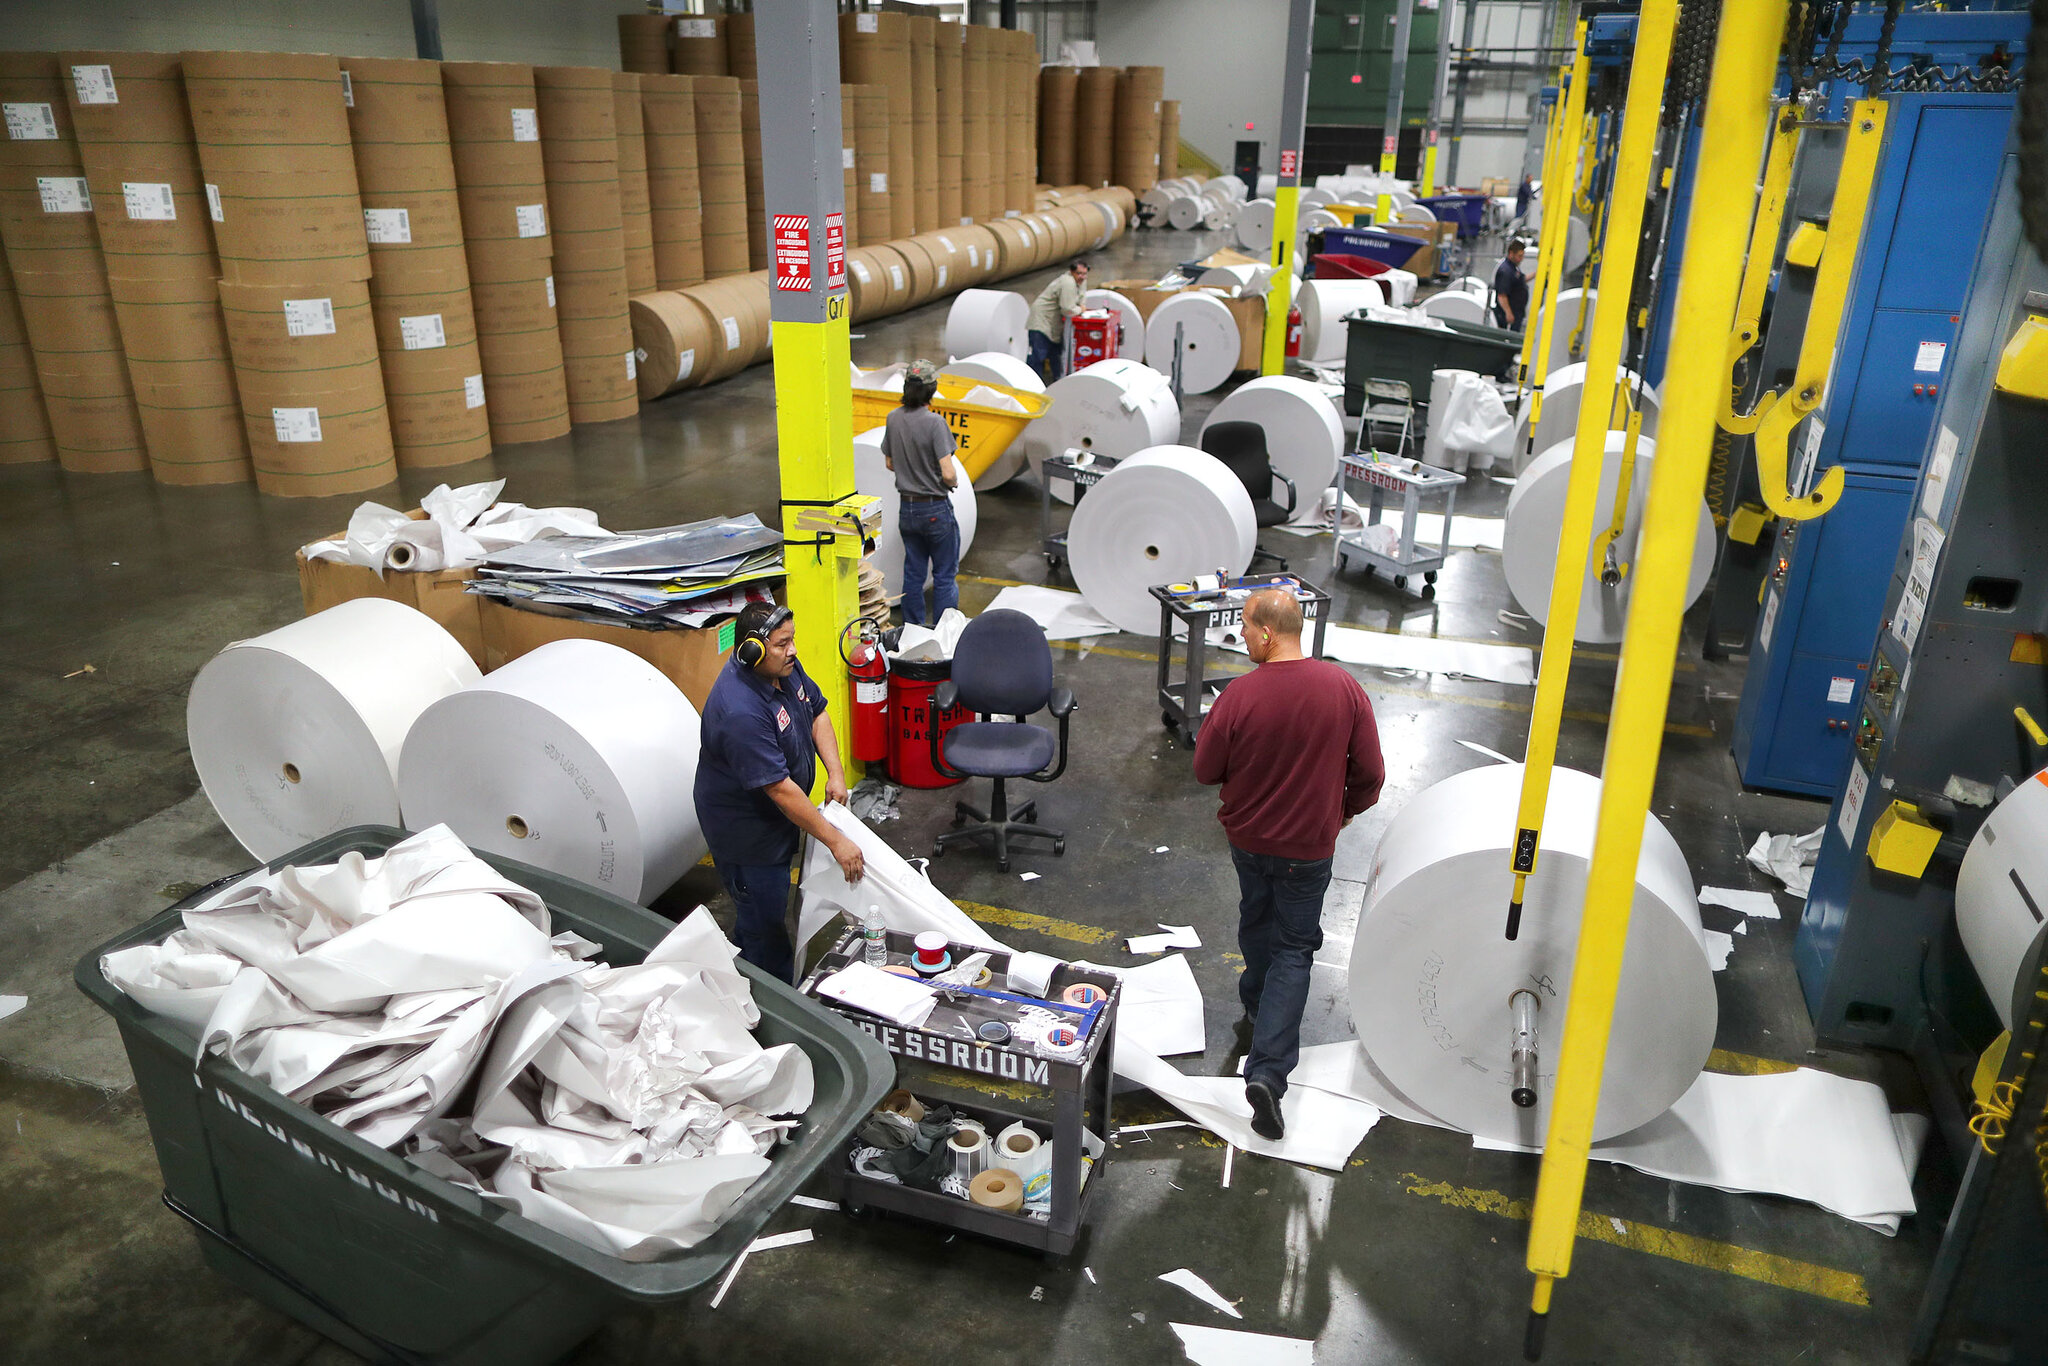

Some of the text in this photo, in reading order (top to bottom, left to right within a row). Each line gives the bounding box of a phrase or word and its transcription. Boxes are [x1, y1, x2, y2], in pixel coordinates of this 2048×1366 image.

[784, 230, 800, 239] FIRE
[1344, 462, 1407, 493] PRESSROOM
[901, 702, 963, 724] TRSH
[598, 840, 615, 883] RESOLUTE
[852, 1019, 1050, 1086] RESSROOM
